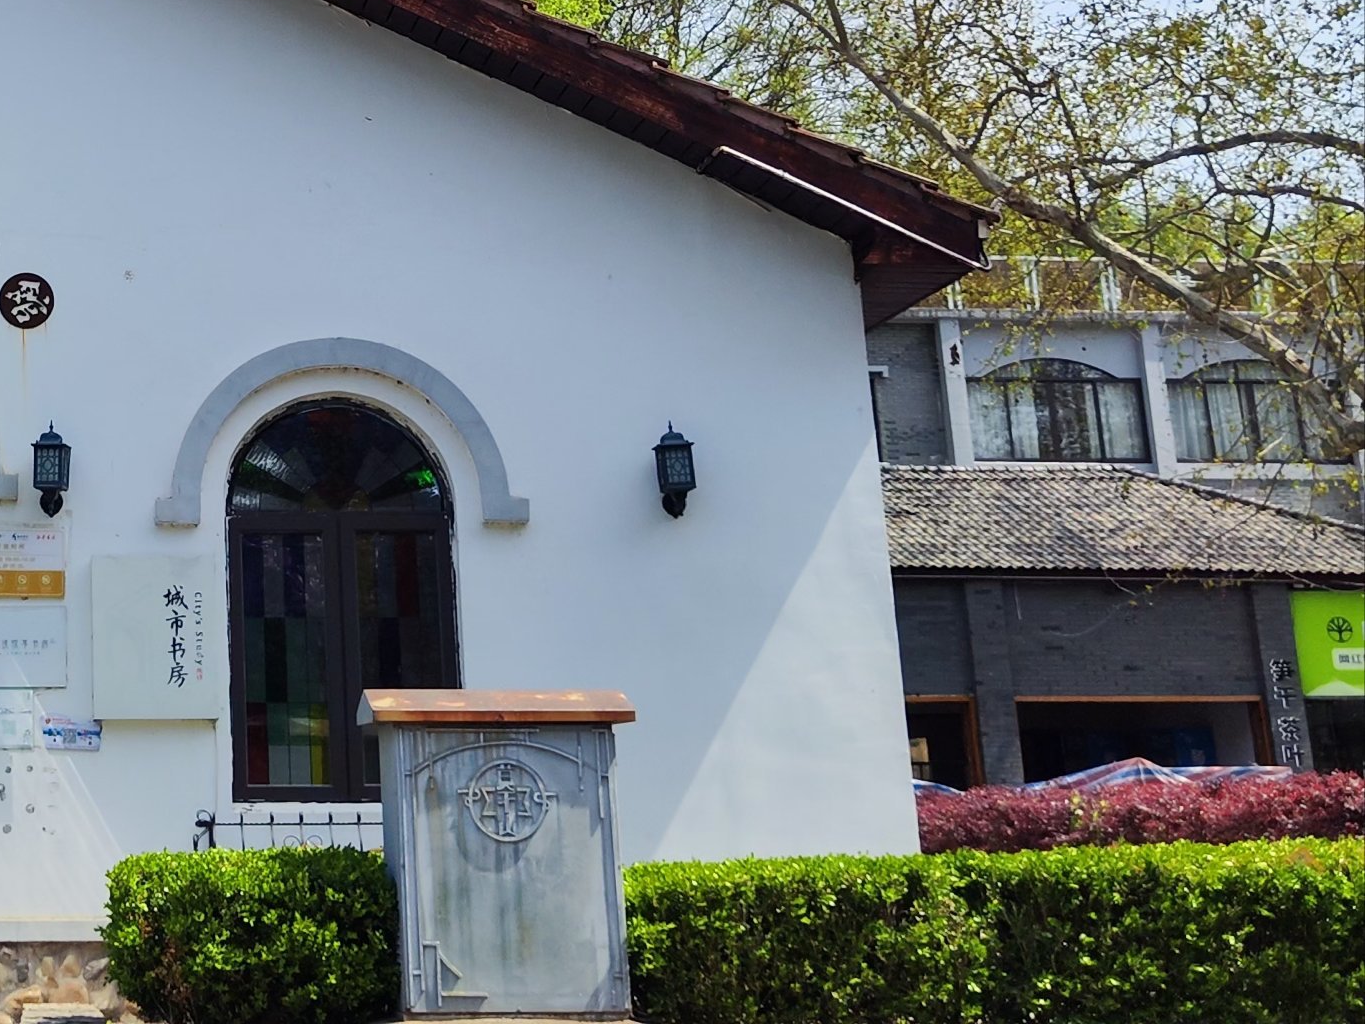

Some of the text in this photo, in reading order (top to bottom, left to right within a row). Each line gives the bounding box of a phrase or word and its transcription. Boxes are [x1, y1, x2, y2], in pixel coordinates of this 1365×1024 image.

[193, 592, 202, 625] City's
[163, 584, 189, 688] 城市书房
[194, 631, 204, 666] Study
